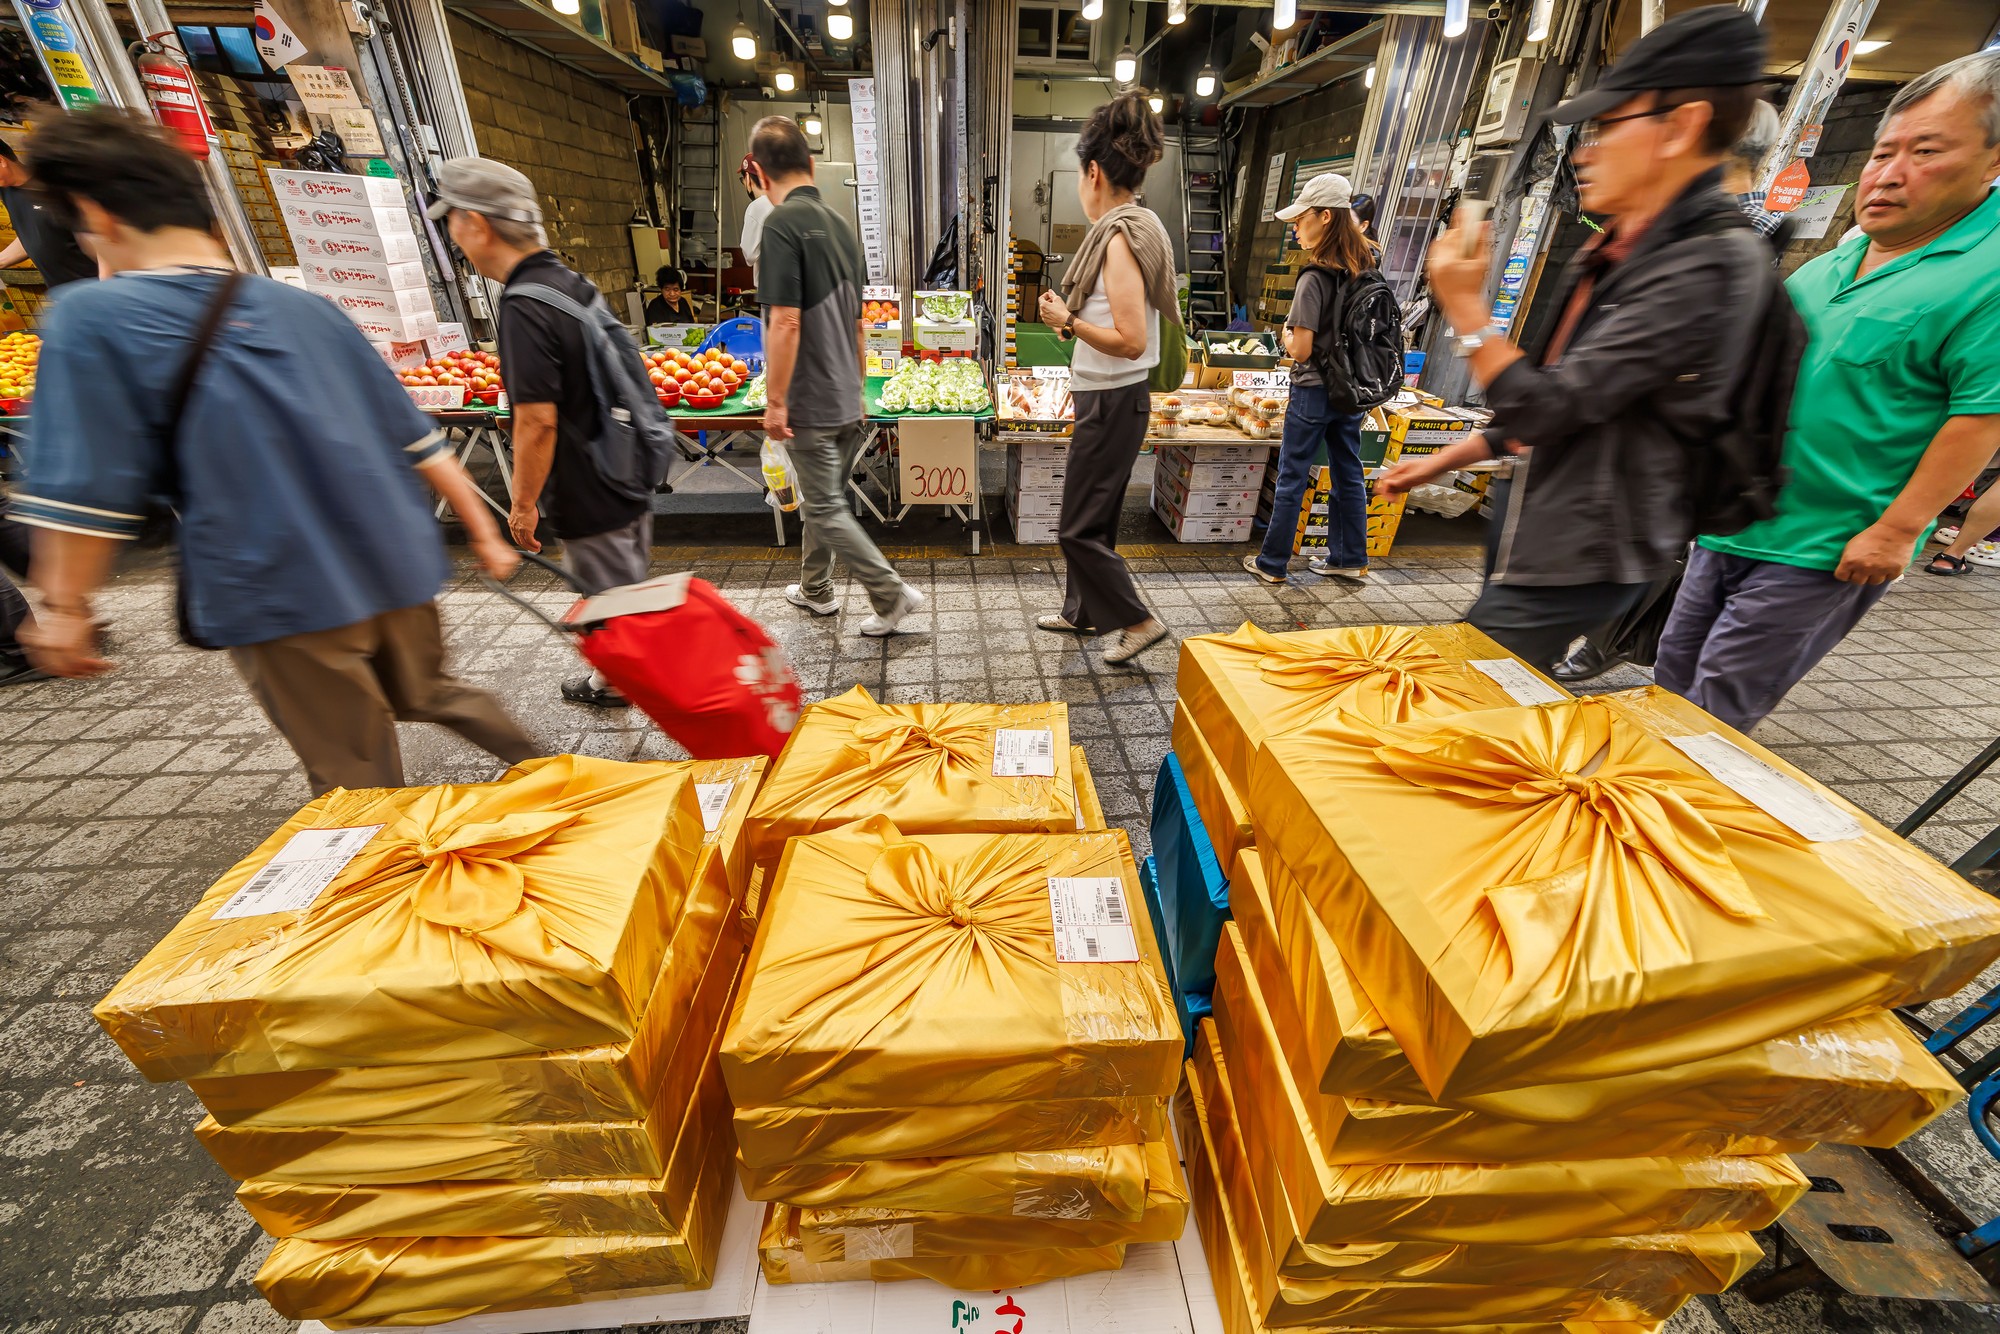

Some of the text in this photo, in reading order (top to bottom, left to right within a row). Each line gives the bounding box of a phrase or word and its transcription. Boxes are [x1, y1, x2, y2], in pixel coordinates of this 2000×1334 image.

[61, 58, 75, 66] pay
[1772, 185, 1804, 197] 온누리상품권
[1053, 898, 1061, 908] 131
[1056, 915, 1063, 924] A2
